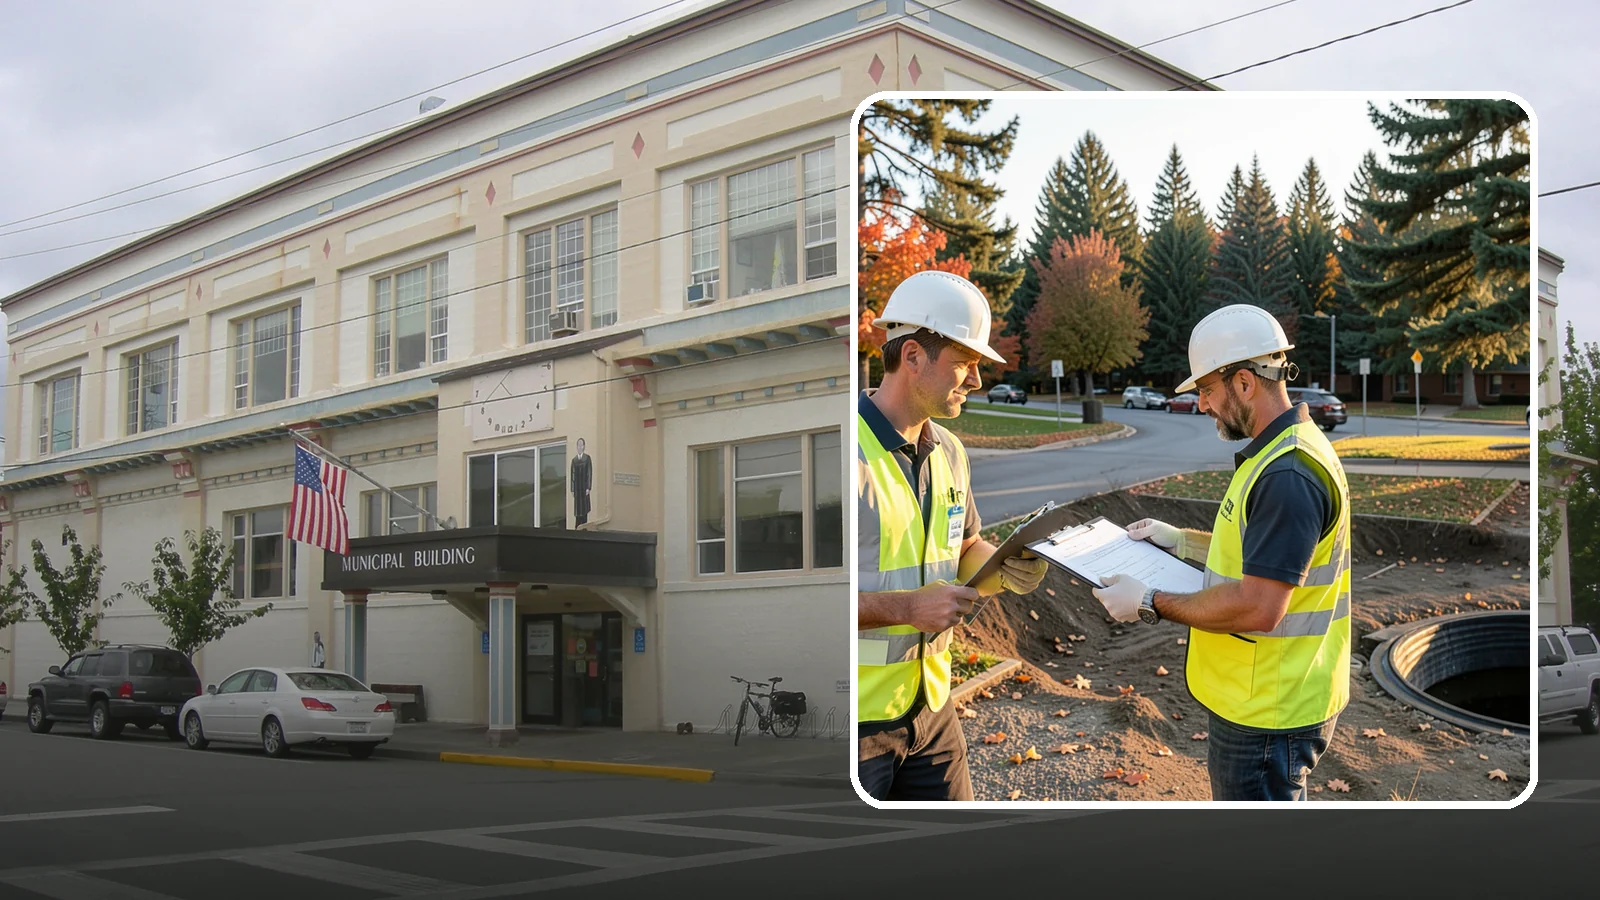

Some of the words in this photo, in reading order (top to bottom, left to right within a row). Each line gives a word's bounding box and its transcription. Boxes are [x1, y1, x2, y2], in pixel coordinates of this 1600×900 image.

[536, 402, 540, 410] 4
[481, 407, 485, 415] 8
[487, 417, 492, 426] 9
[529, 414, 533, 422] 3
[521, 420, 526, 428] 2
[501, 425, 506, 433] 11
[507, 425, 513, 433] 12
[342, 552, 405, 571] MUNICIPAL
[414, 546, 475, 567] BUILDING
